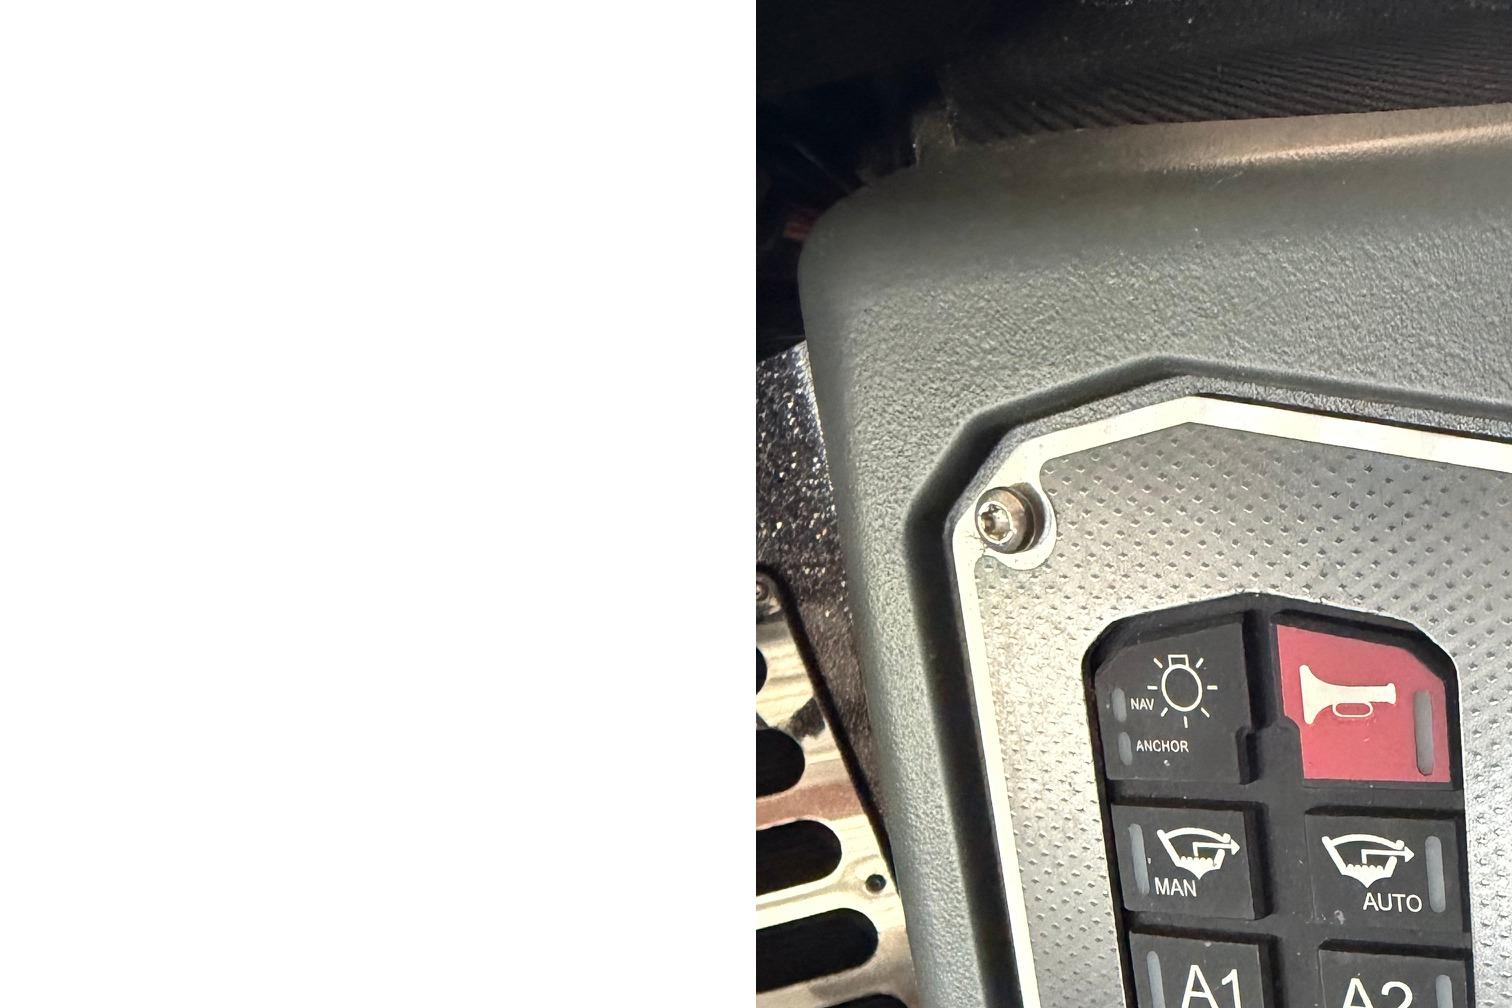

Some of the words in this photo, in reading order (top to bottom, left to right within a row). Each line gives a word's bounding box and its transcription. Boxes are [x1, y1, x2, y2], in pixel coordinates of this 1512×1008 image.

[1130, 698, 1155, 711] NAV
[1136, 740, 1189, 753] ANCHOR
[1154, 878, 1197, 897] MAN
[1362, 893, 1423, 913] AUTO
